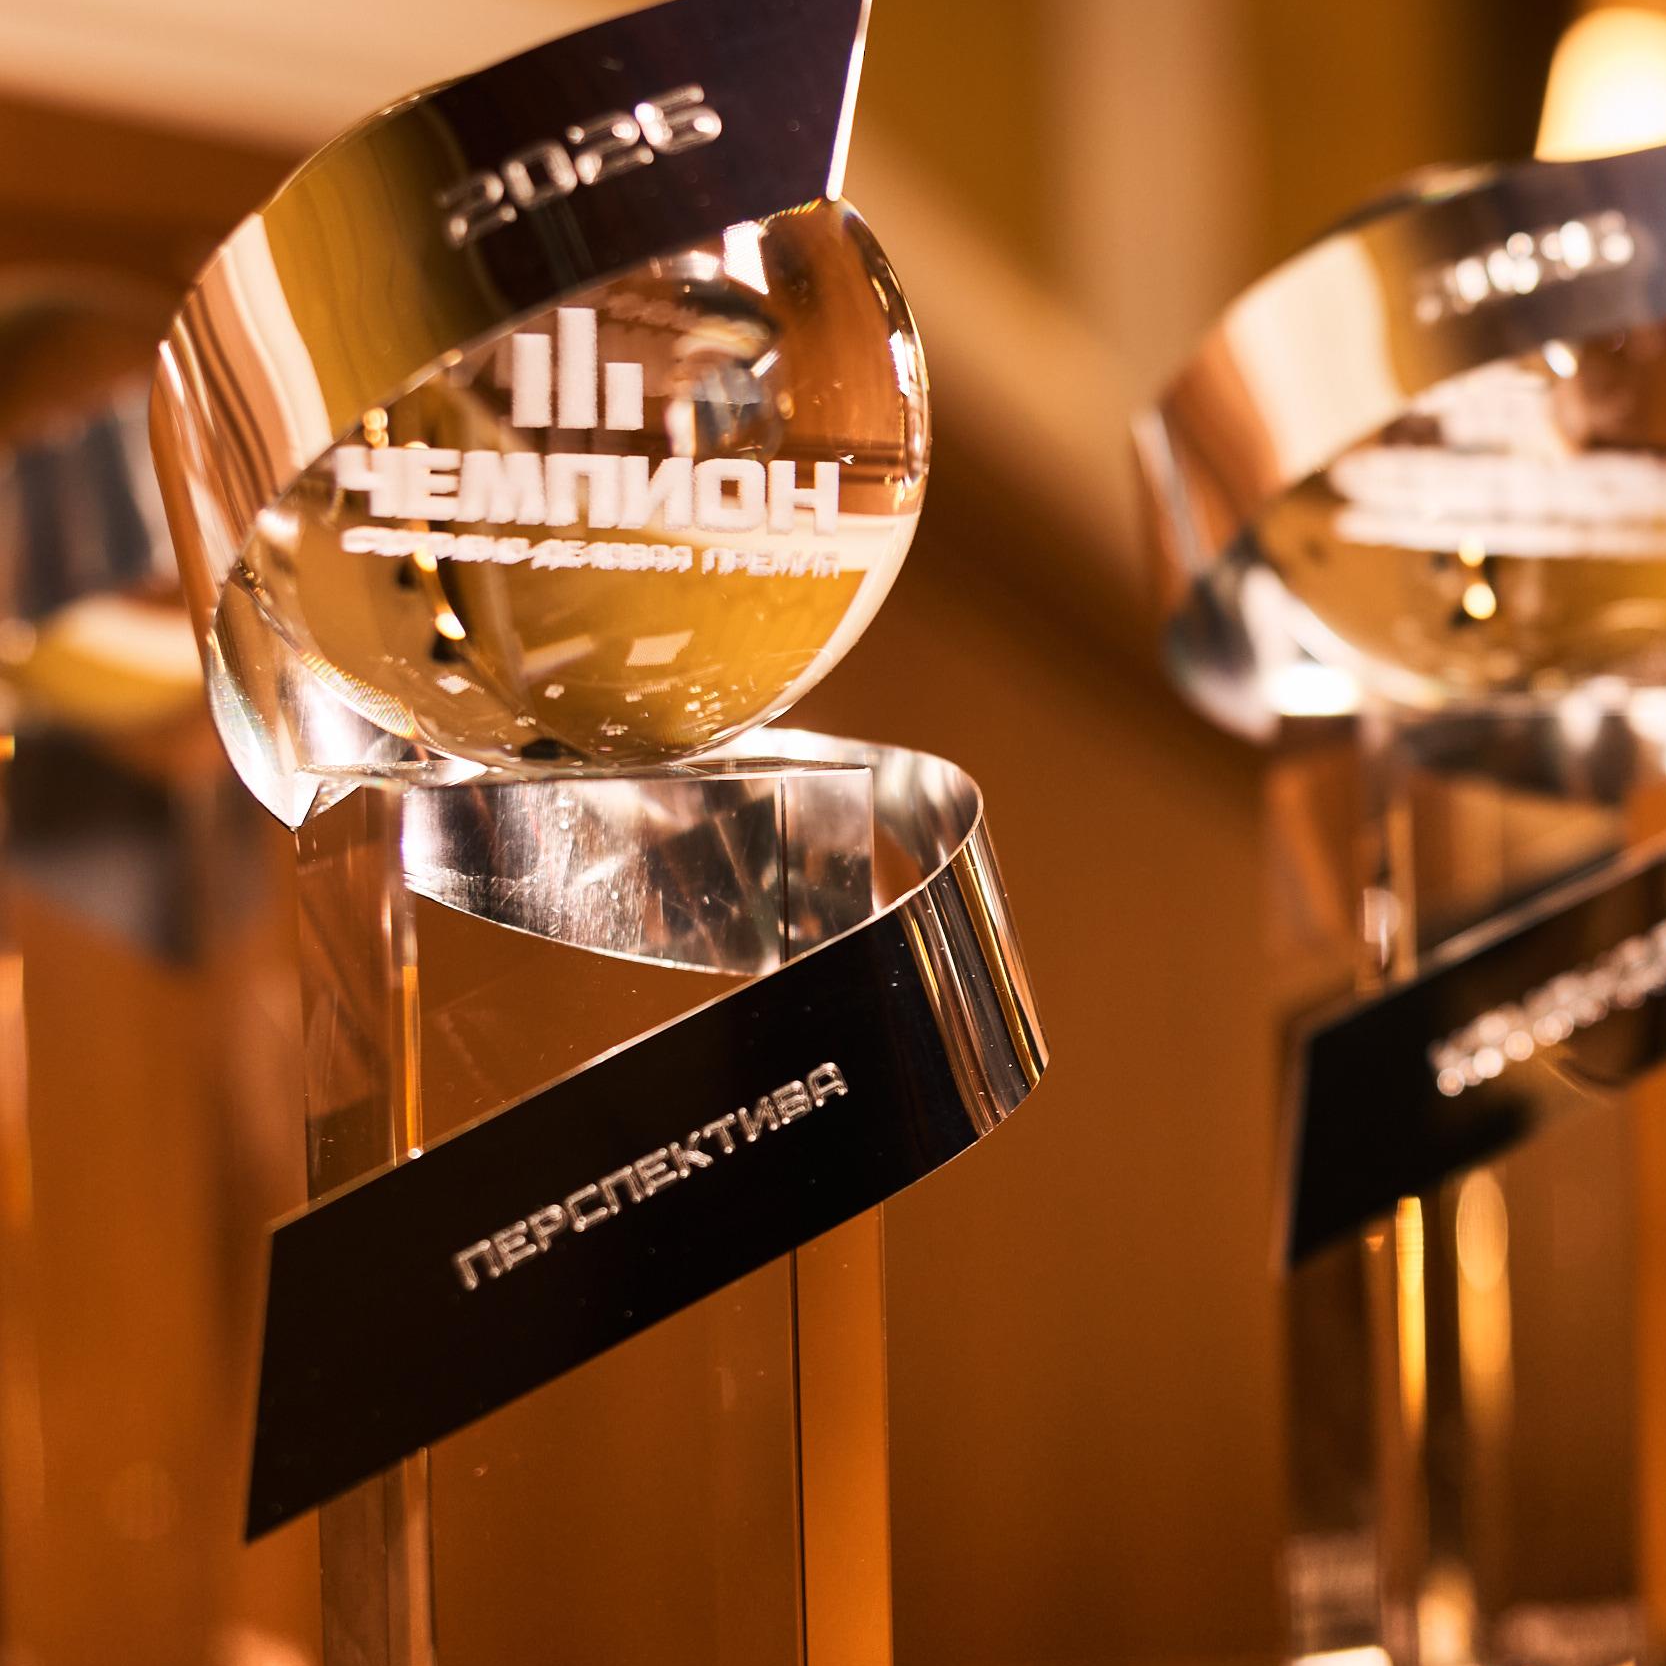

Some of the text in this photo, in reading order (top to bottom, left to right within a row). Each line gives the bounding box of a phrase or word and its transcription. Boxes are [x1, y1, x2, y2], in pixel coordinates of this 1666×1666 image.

[436, 83, 722, 248] 2026
[335, 445, 839, 535] ЧЕМПИОН
[451, 1060, 849, 1292] ПЕРСПЕКТИВА
